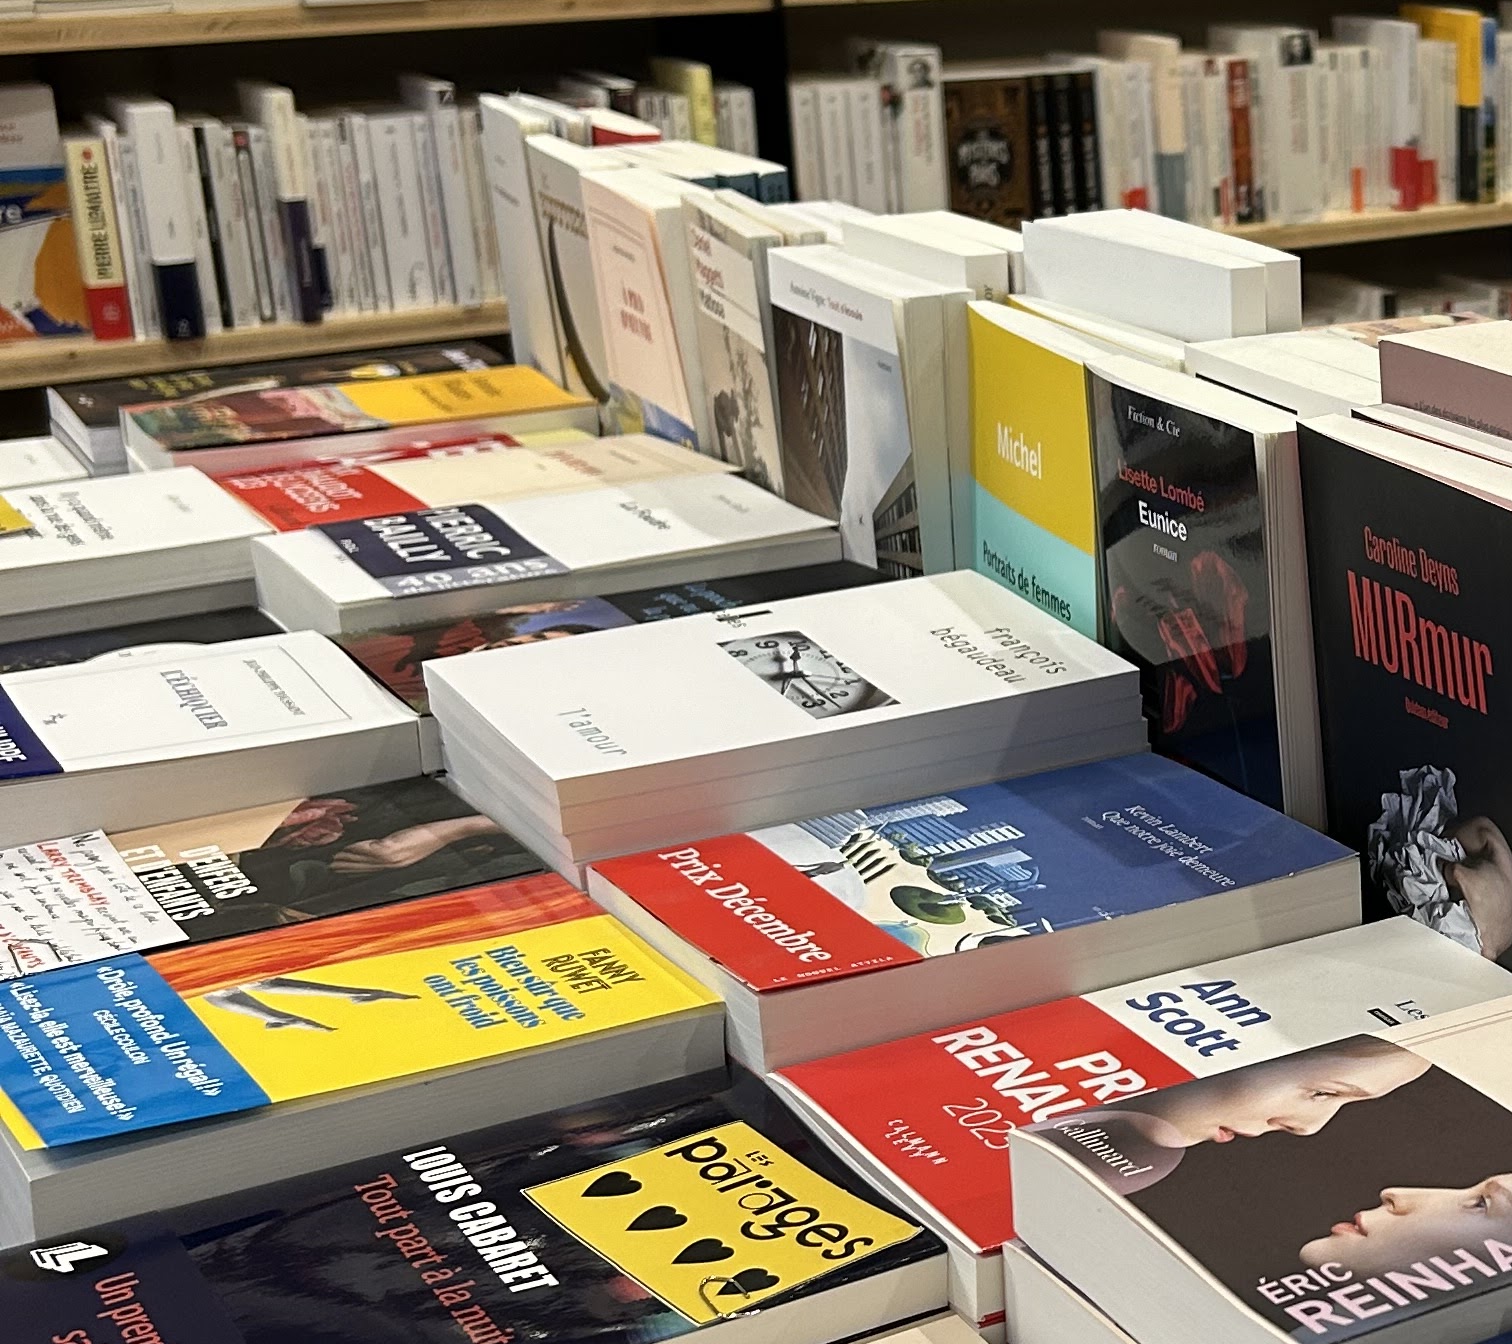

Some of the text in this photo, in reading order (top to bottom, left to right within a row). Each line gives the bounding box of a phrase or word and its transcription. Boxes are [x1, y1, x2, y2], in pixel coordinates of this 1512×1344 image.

[996, 420, 1043, 482] Michel
[1117, 457, 1206, 513] Lisette Lombé
[363, 516, 452, 564] BAILLY
[1137, 499, 1188, 543] Eunice
[1363, 524, 1460, 598] Caroline Deyns
[1030, 576, 1073, 623] femmes
[929, 626, 1026, 685] bégaudeau
[982, 624, 1068, 677] françois
[1346, 568, 1494, 716] MURmur
[561, 706, 628, 757] l'amour
[1124, 805, 1163, 827] Kevin
[1158, 823, 1213, 854] Lambert
[1178, 854, 1236, 888] demeure
[657, 846, 833, 964] Prix Décembre
[485, 944, 527, 974] Bien
[577, 947, 646, 986] FANNY
[445, 990, 509, 1030] froid
[1125, 991, 1242, 1058] Scott
[1180, 979, 1272, 1028] Ann
[1052, 1116, 1153, 1179] Gallimard
[353, 1173, 395, 1217] Tout
[377, 1216, 425, 1264] part
[402, 1145, 562, 1296] LOUIS CABARET
[663, 1134, 877, 1263] parages
[94, 1271, 136, 1312] Un
[1257, 1263, 1353, 1308] ÉRIC
